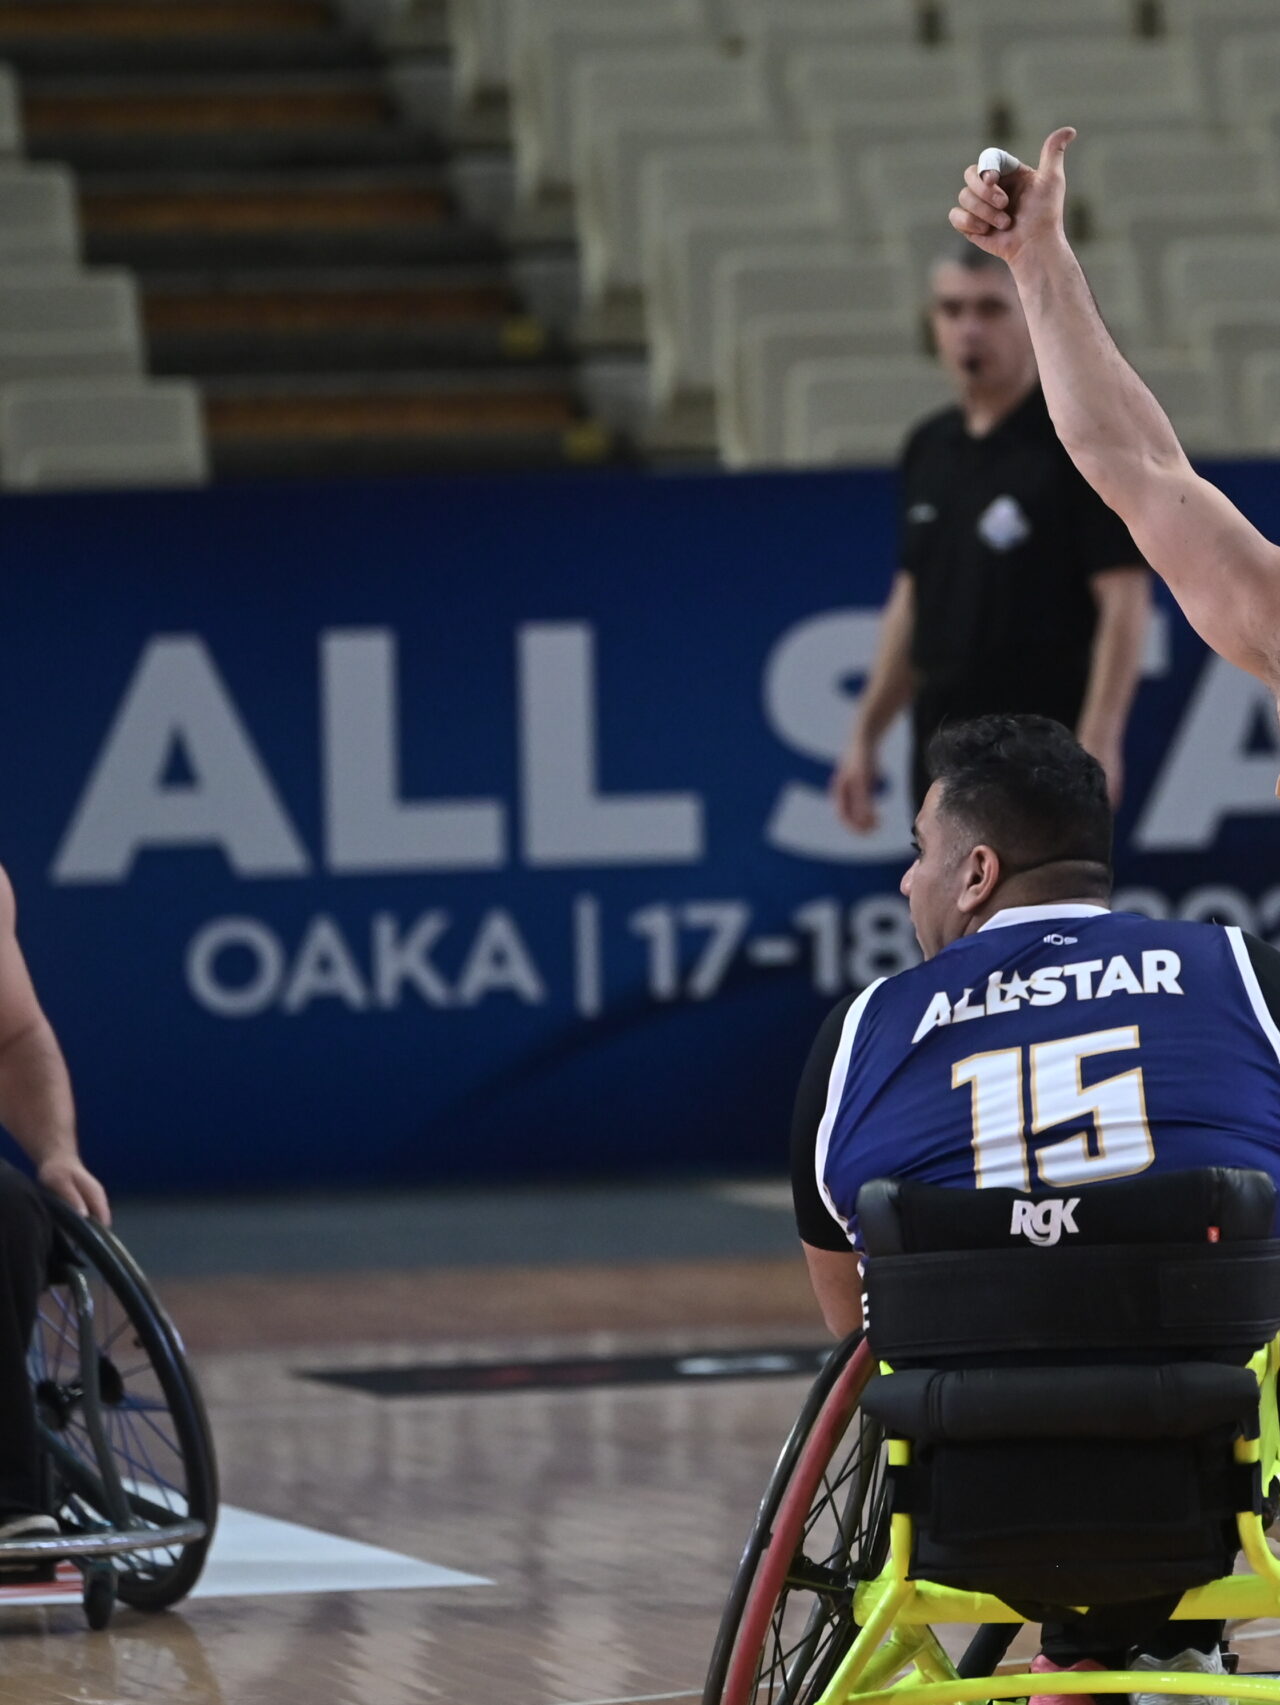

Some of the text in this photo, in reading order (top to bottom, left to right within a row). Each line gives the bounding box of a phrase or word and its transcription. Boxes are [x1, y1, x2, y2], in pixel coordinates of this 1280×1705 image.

[52, 619, 705, 884] ALL
[187, 907, 545, 1018] OAKA
[627, 893, 920, 1003] 17-18
[911, 949, 1185, 1044] ALL STAR
[951, 1025, 1156, 1193] 15
